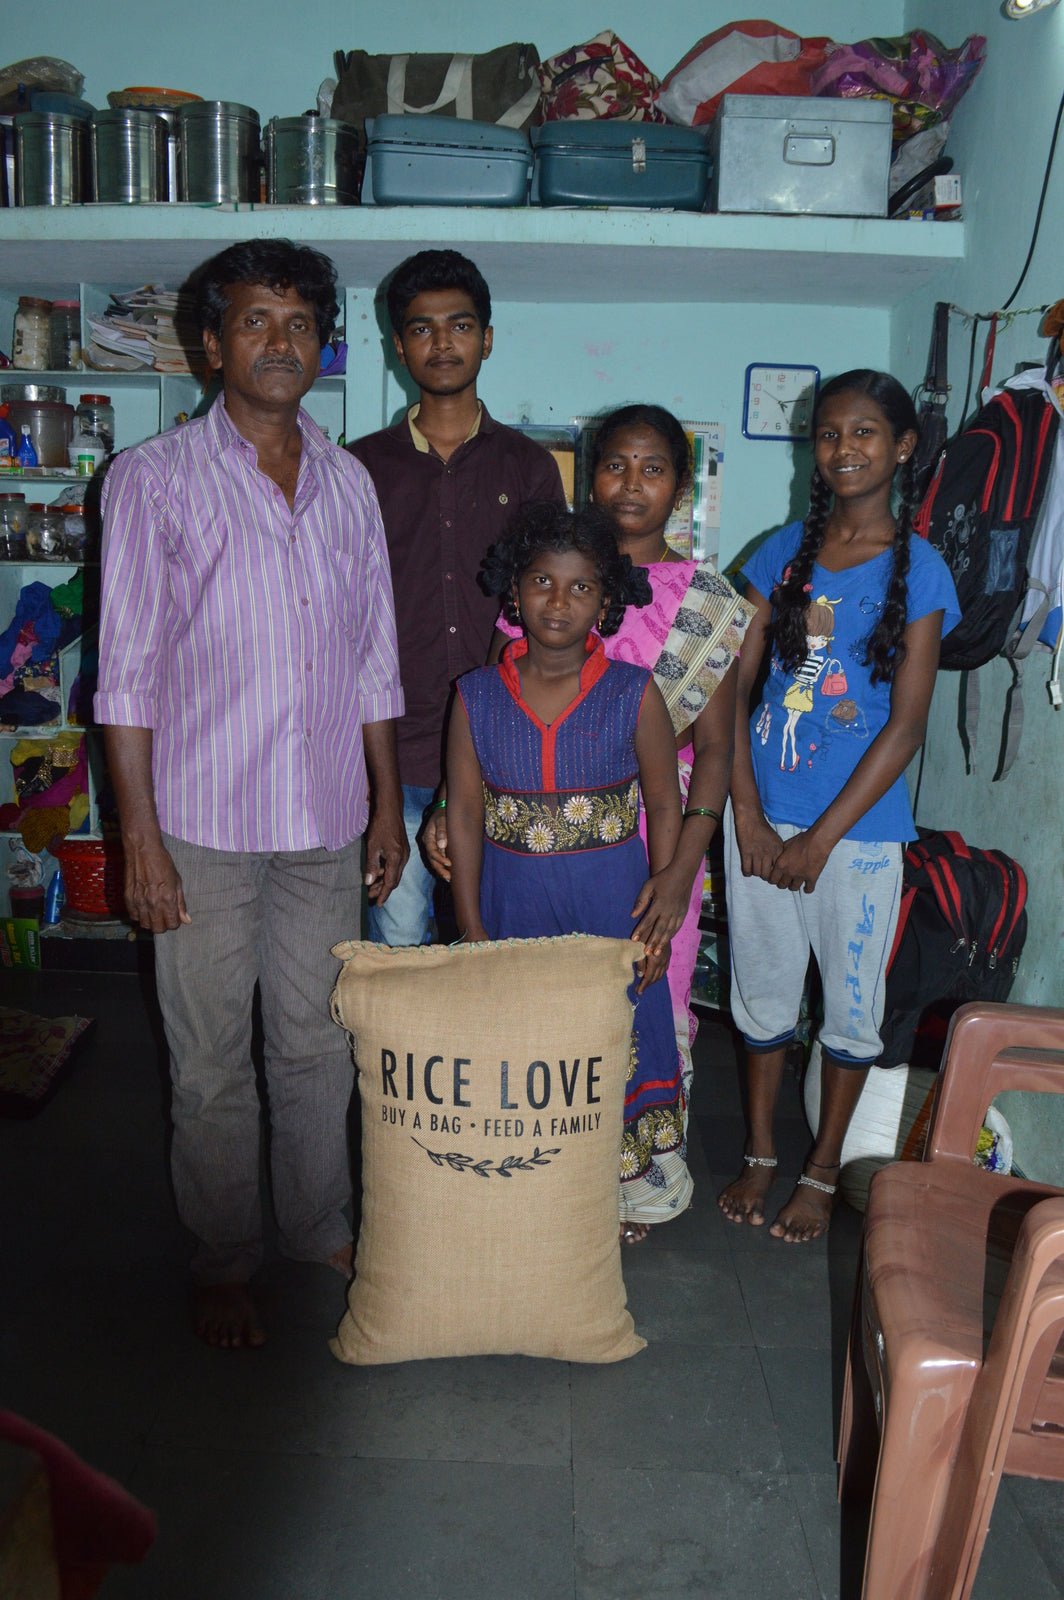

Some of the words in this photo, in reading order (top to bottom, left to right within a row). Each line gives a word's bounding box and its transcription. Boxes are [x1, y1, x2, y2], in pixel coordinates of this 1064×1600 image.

[752, 383, 762, 392] 10
[777, 374, 786, 383] 12
[849, 855, 890, 875] Apple
[381, 1048, 472, 1108] RICE
[500, 1056, 602, 1111] LOVE
[381, 1105, 406, 1126] BUY
[413, 1112, 421, 1129] A
[430, 1113, 461, 1134] BAG
[484, 1119, 524, 1137] FEED
[533, 1120, 542, 1137] A
[551, 1112, 601, 1136] FAMILY
